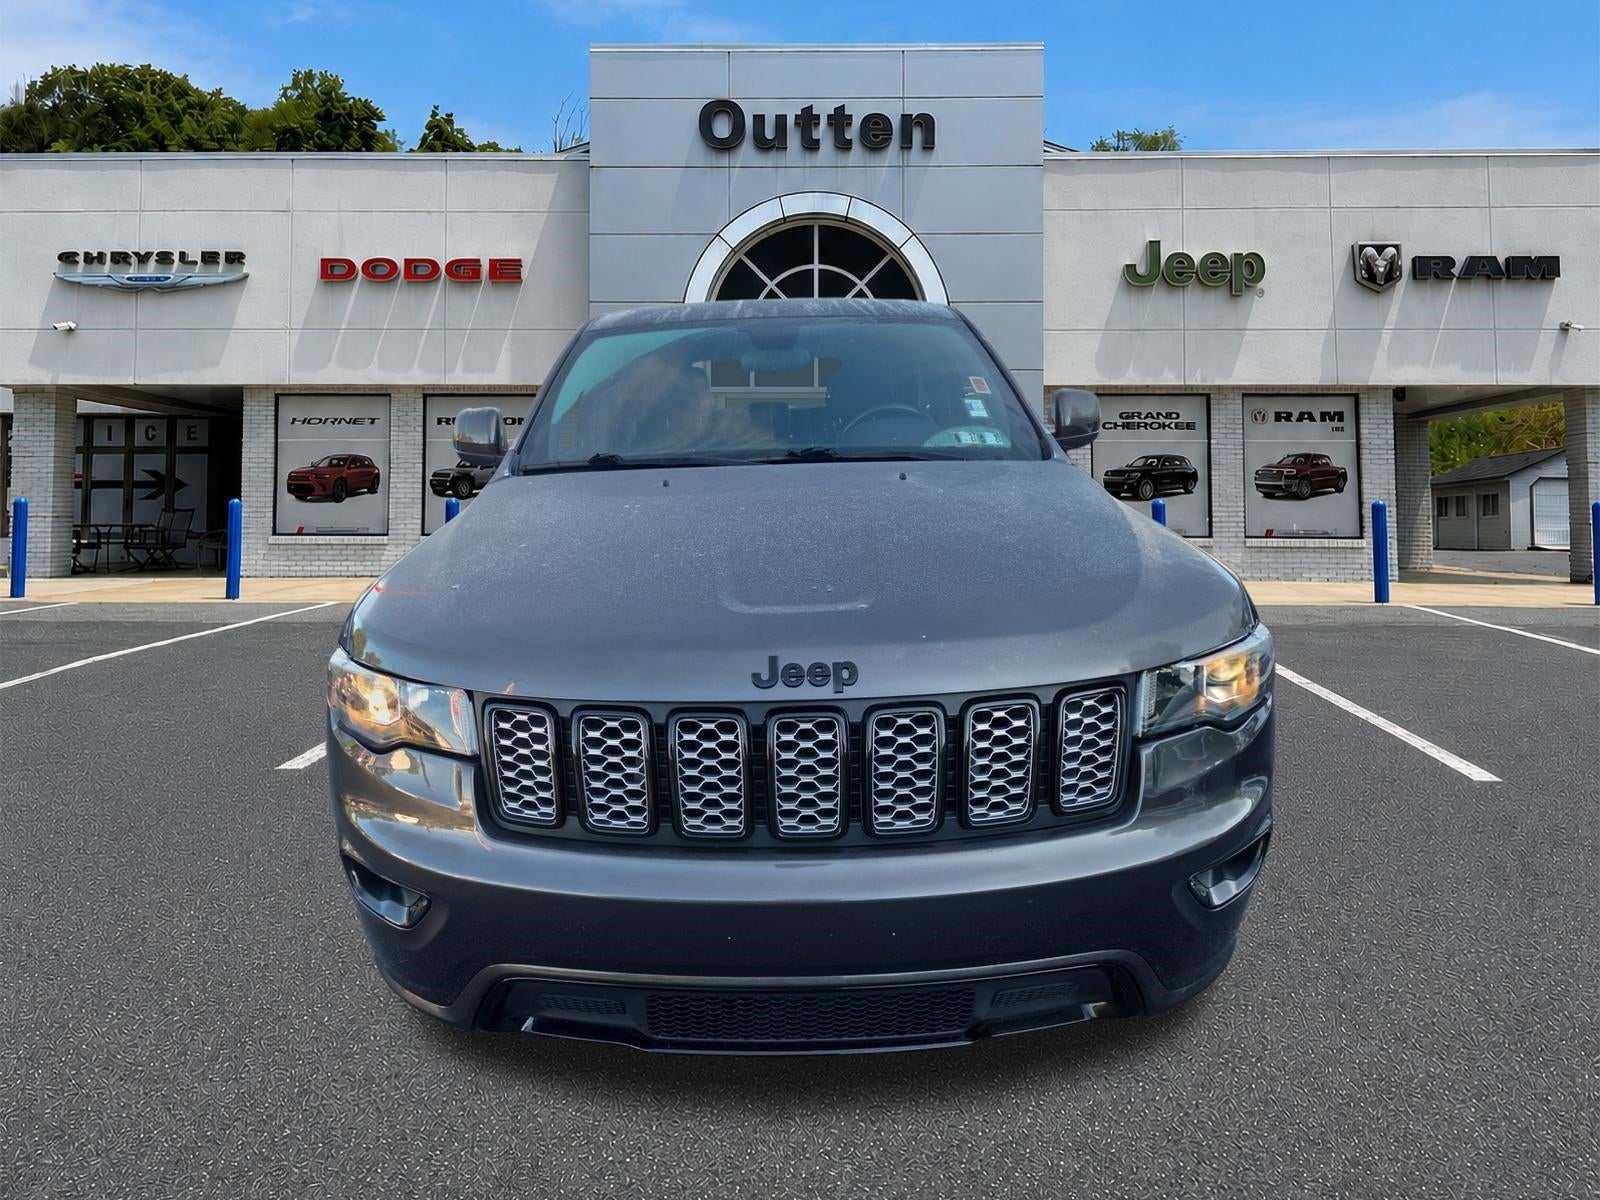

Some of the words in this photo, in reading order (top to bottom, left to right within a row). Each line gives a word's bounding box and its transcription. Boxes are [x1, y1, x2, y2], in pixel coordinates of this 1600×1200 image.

[699, 99, 936, 150] Outten
[57, 250, 247, 266] CHRYSLER
[1123, 240, 1266, 296] Jeep
[1411, 255, 1561, 281] RAM
[320, 257, 523, 283] DODGE
[290, 417, 381, 426] HORNET
[1101, 421, 1197, 431] CHEROKEE
[1118, 411, 1180, 421] GRAND
[1274, 411, 1345, 423] RAM
[751, 655, 859, 694] Jeep
